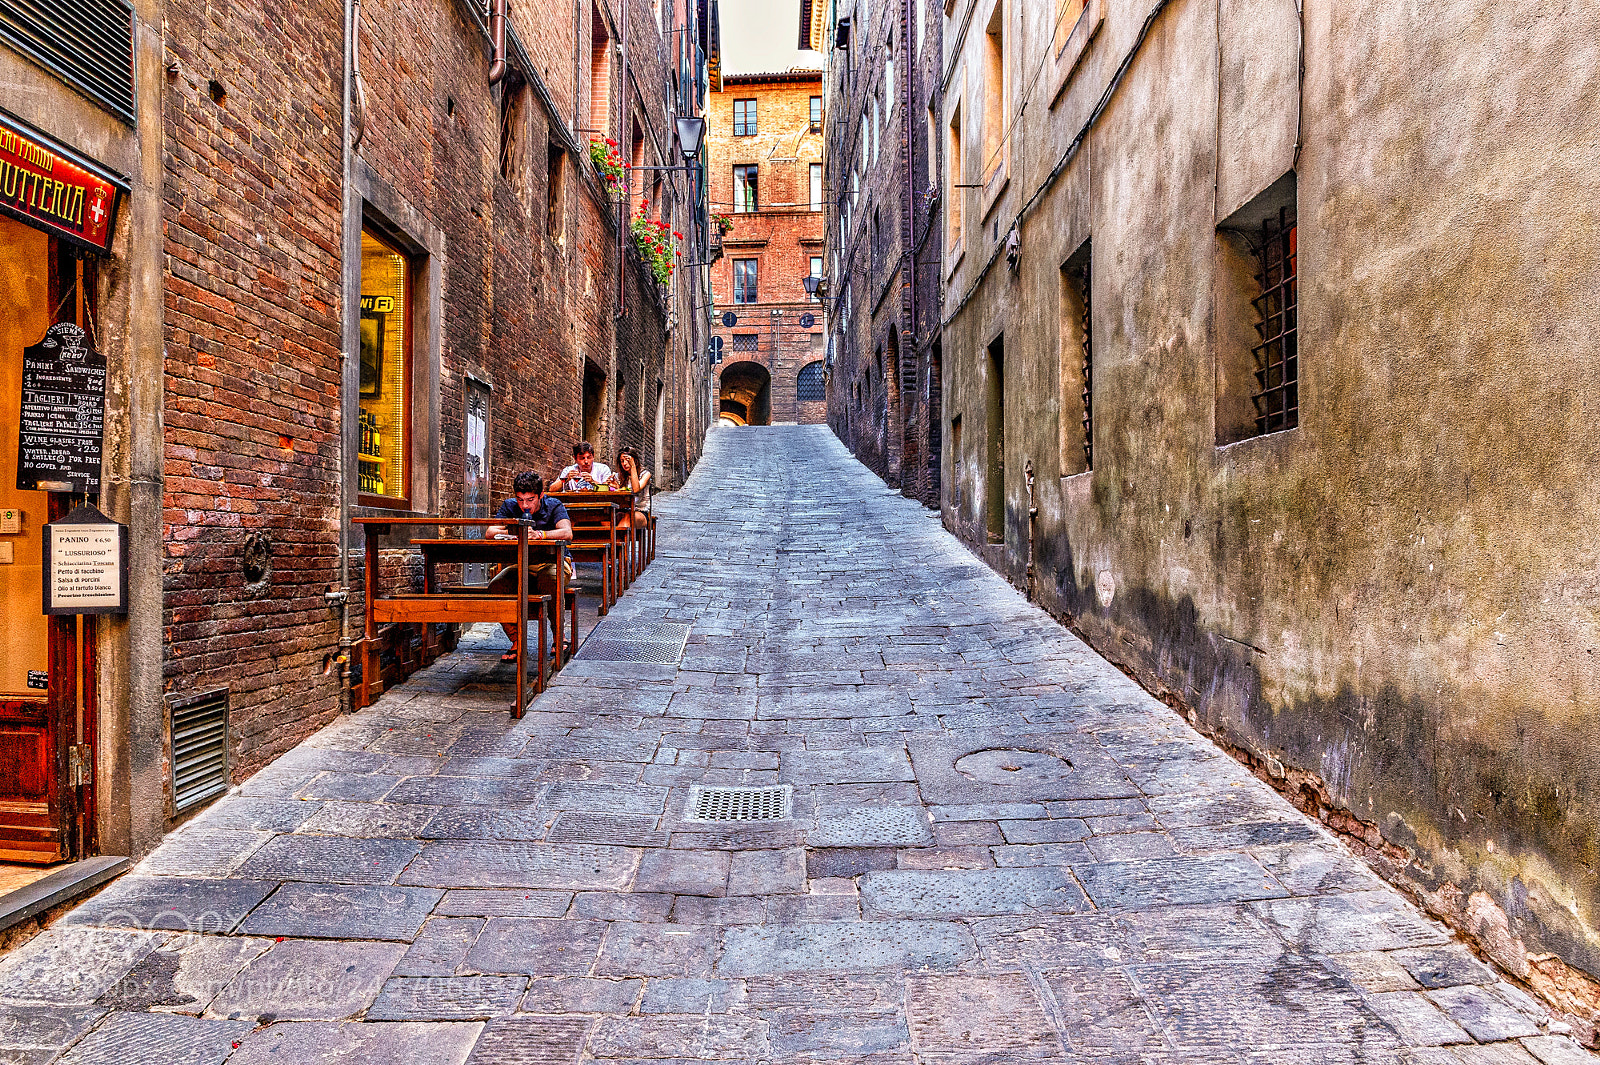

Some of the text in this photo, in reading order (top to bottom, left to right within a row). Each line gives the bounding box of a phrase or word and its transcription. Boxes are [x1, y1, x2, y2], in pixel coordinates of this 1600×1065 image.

[18, 140, 53, 171] PANINI
[378, 299, 391, 310] Fi
[57, 327, 78, 336] SIENA
[25, 360, 106, 376] PANINI SANDWICHES
[25, 391, 100, 404] TAGLIERI TASTING
[24, 435, 48, 443] WINE
[78, 438, 94, 446] FROM
[68, 455, 83, 463] FOR
[85, 456, 101, 464] FREE
[23, 461, 34, 469] NO
[36, 462, 57, 470] COVER
